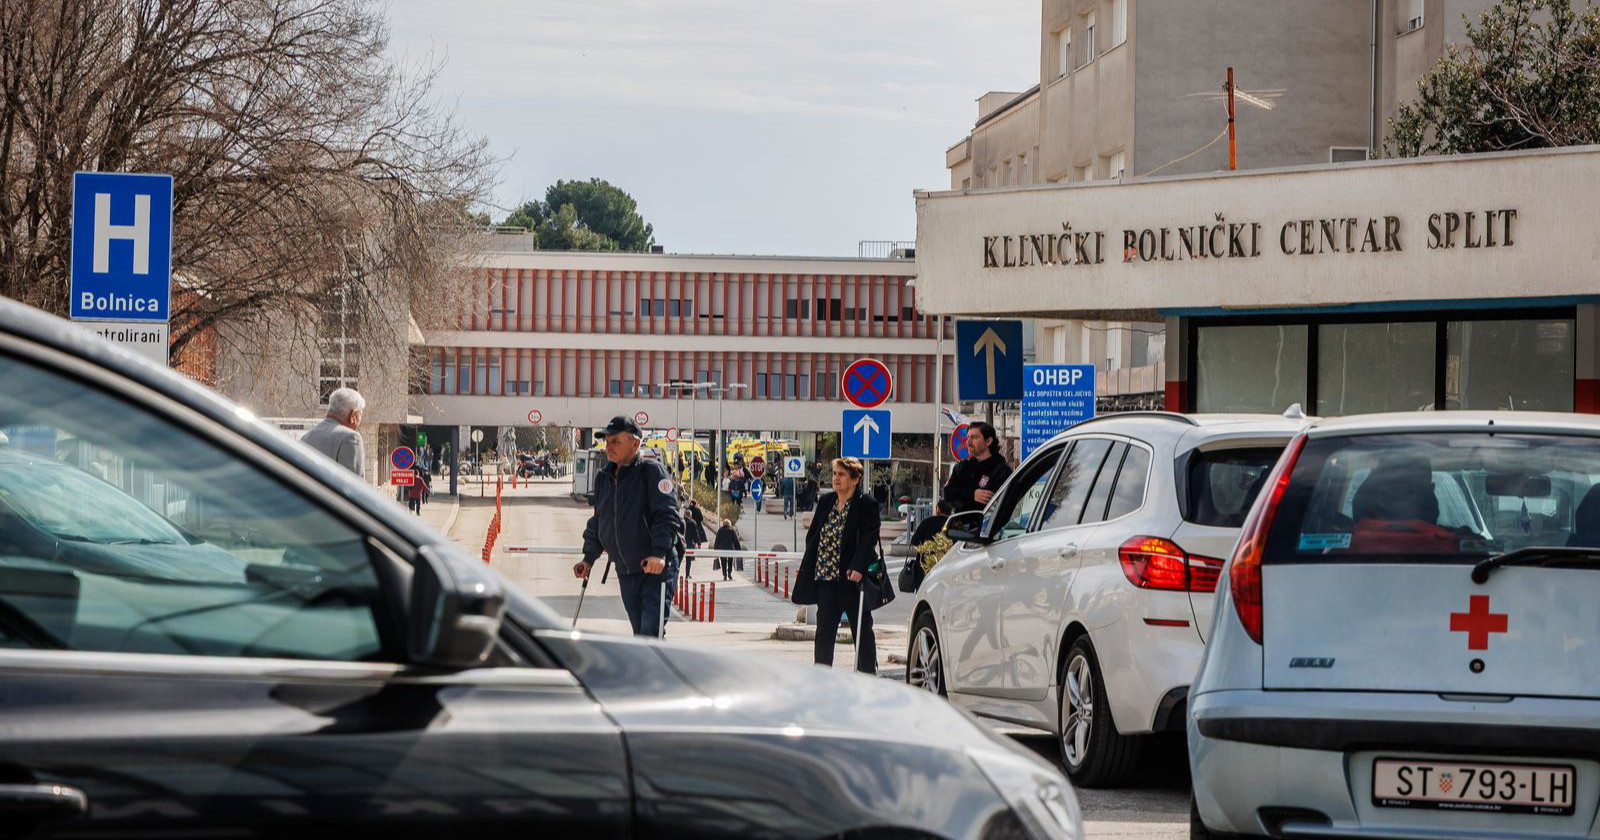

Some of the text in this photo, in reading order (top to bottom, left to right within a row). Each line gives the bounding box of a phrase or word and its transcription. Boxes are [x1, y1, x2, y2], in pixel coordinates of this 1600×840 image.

[93, 193, 151, 275] H
[982, 209, 1518, 269] KLINIČKI BOLNIČKI CENTAR SPLIT
[81, 291, 159, 312] Bolnica
[1033, 368, 1083, 385] OHBP
[750, 462, 765, 472] STOP
[1397, 766, 1433, 796] ST
